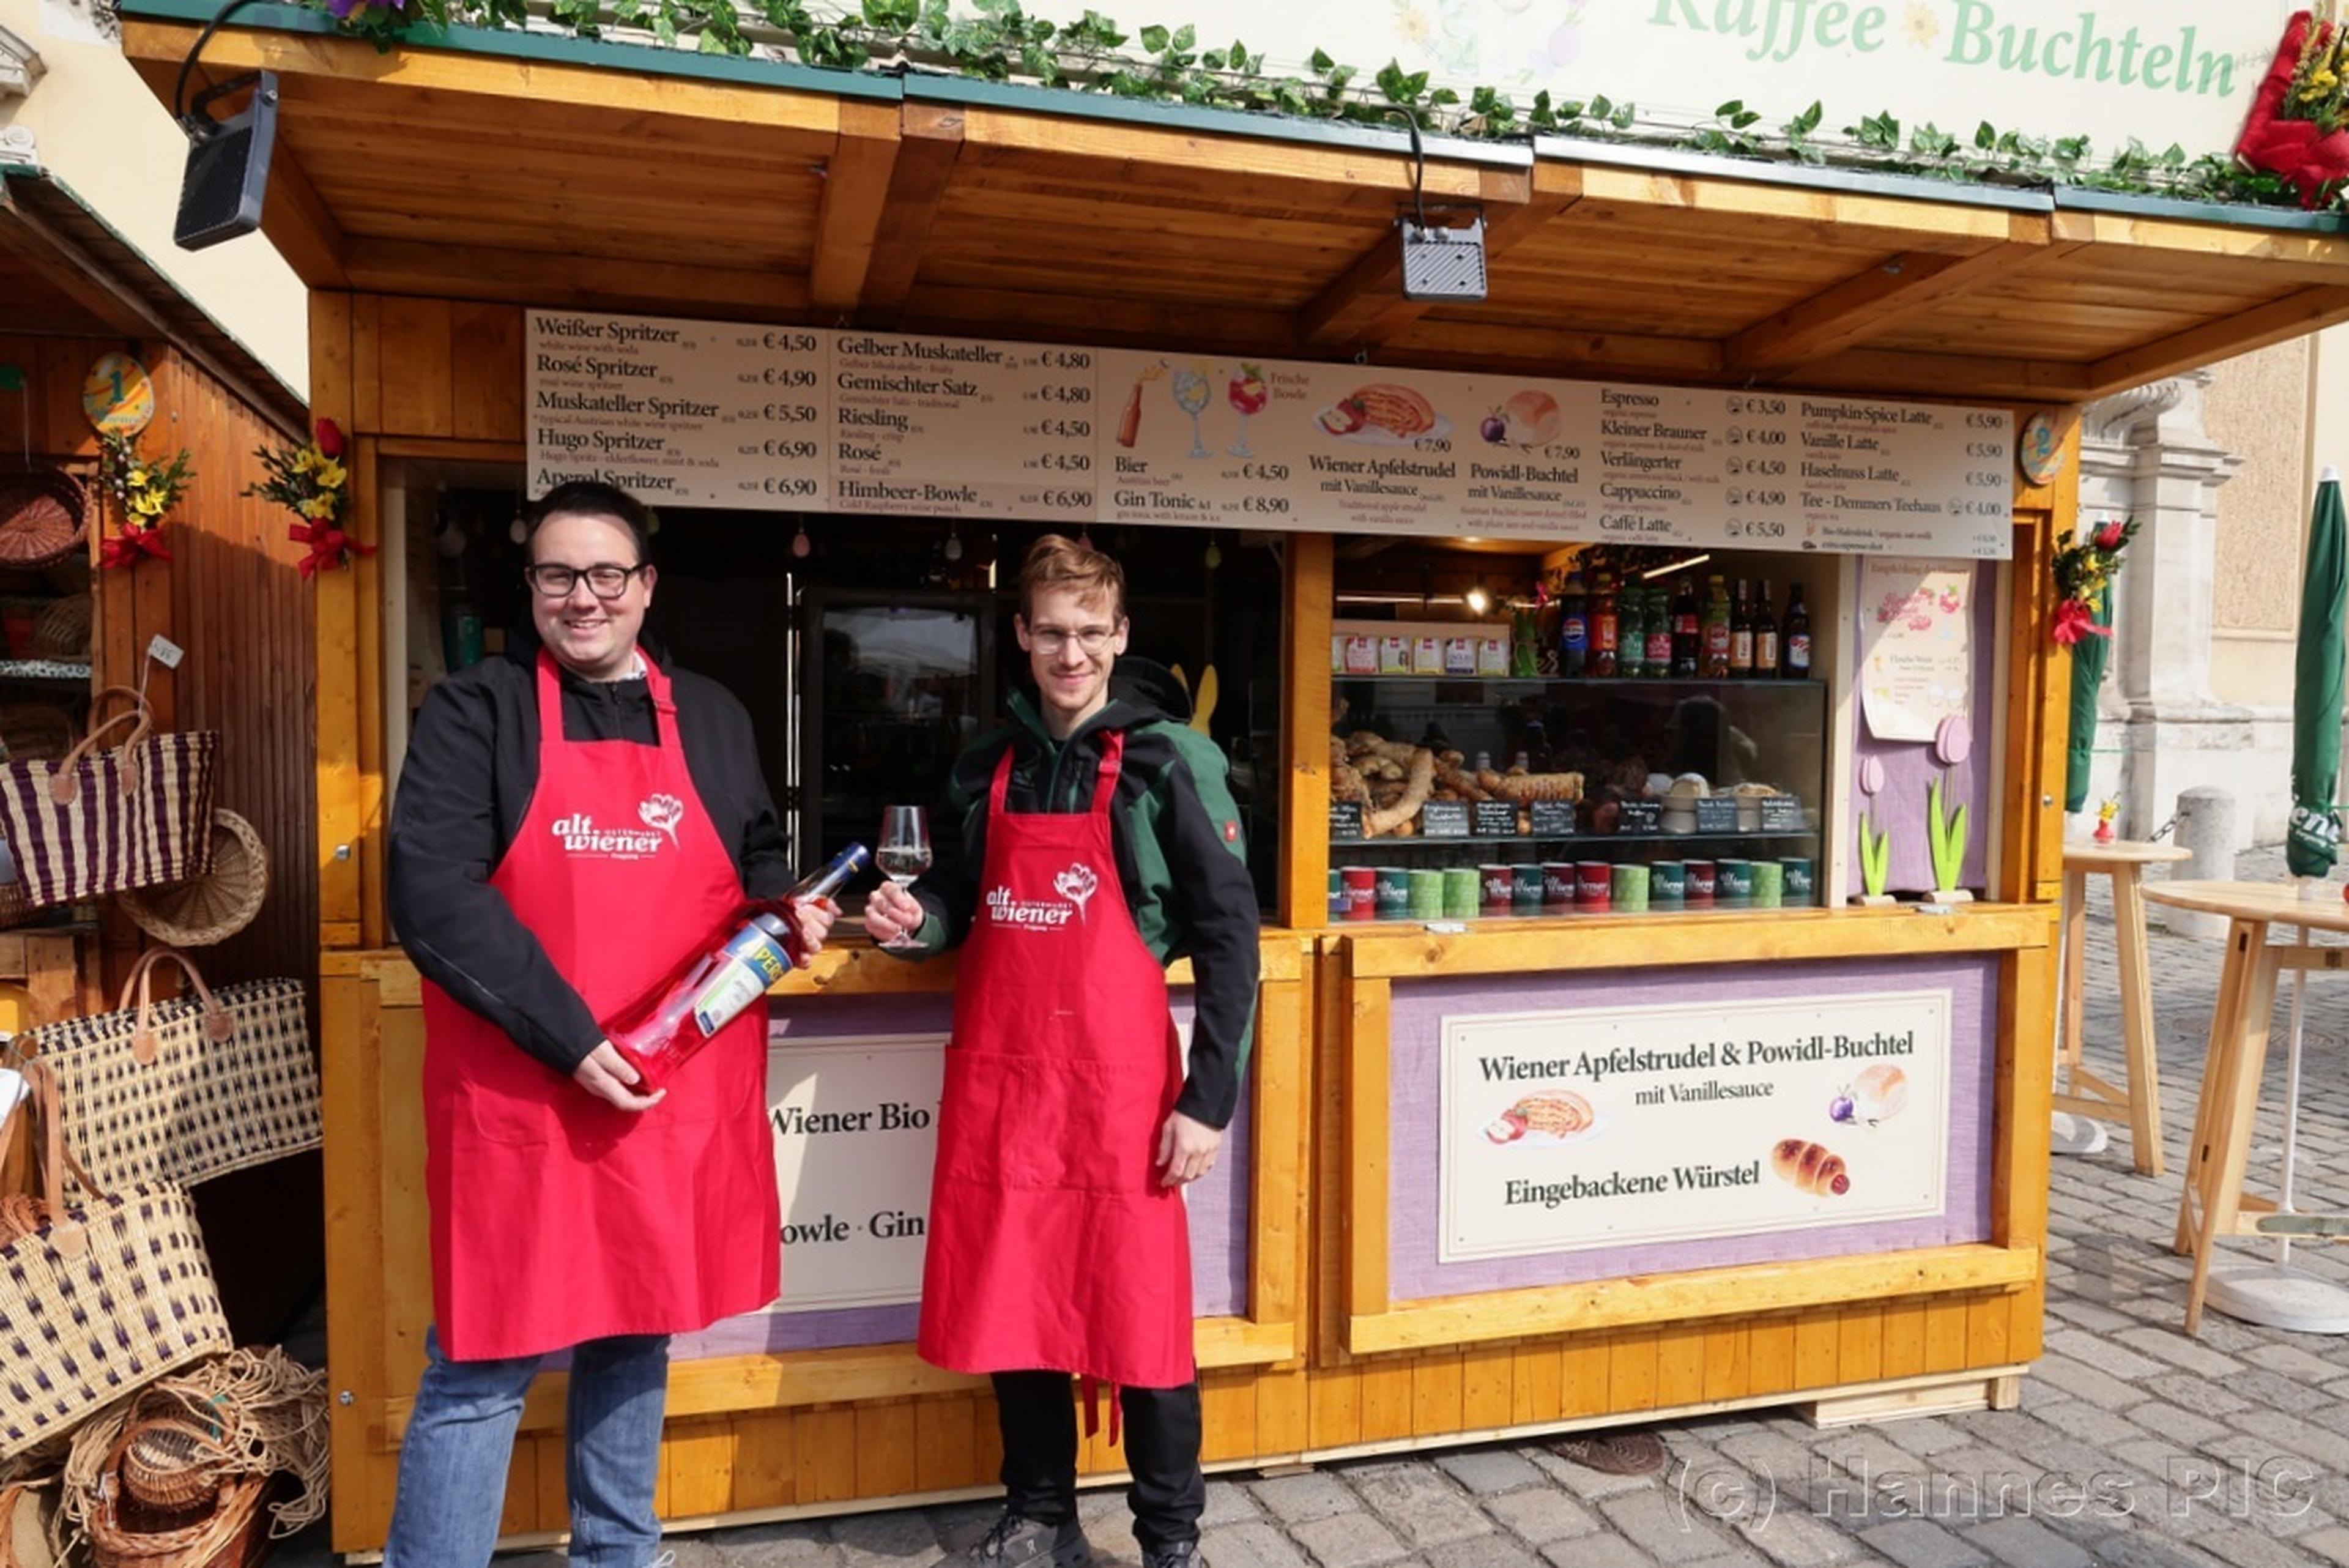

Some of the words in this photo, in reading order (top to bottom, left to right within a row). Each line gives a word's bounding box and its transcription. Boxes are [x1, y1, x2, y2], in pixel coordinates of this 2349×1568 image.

[1943, 0, 2235, 97] Buchteln
[536, 317, 604, 339] Weißer
[607, 323, 679, 346] Spritzer
[779, 334, 817, 352] 4,50
[837, 336, 898, 357] Gelber
[901, 343, 1003, 365] Muskateller
[1055, 352, 1090, 369] 4,80
[536, 355, 582, 373] Rosé
[585, 357, 658, 382] Spritzer
[779, 371, 816, 388] 4,90
[110, 371, 123, 404] 1
[837, 372, 940, 395] Gemischter
[943, 378, 978, 396] Satz
[1055, 387, 1091, 403] 4,80
[536, 392, 645, 414] Muskateller
[648, 398, 719, 422] Spritzer
[779, 406, 817, 423] 5,50
[1601, 388, 1659, 407] Espresso
[1758, 400, 1785, 414] 3,50
[838, 407, 908, 433] Riesling
[1055, 421, 1090, 437] 4,50
[1901, 409, 1932, 425] Latte
[1977, 415, 2002, 428] 5,90
[537, 429, 589, 452] Hugo
[592, 431, 665, 455] Spritzer
[779, 442, 817, 459] 6,90
[1601, 420, 1649, 437] Kleiner
[1653, 423, 1707, 439] Brauner
[1758, 431, 1785, 445] 4,00
[2037, 428, 2051, 455] 2
[838, 443, 881, 461] Rosé
[1055, 455, 1090, 470] 4,50
[1801, 433, 1844, 449] Vanille
[1847, 435, 1879, 450] Latte
[1977, 444, 2002, 458] 5,90
[1115, 456, 1148, 474] Bier
[1256, 464, 1289, 480] 4,50
[1309, 455, 1364, 474] Wiener
[1367, 458, 1455, 478] Apfelstrudel
[1600, 451, 1681, 471] Verlängerter
[1758, 461, 1785, 475] 4,50
[1800, 462, 1865, 479] Haselnuss
[1868, 466, 1899, 481] Latte
[1977, 474, 2002, 487] 5,90
[603, 471, 676, 491] Spritzer
[779, 480, 817, 498] 6,90
[838, 481, 977, 503] Himbeer-Bowle
[1056, 492, 1091, 508] 6,90
[1321, 480, 1341, 492] mit
[1345, 481, 1418, 496] Vanillesauce
[1469, 488, 1488, 498] mit
[1491, 488, 1562, 502] Vanillesauce
[1600, 483, 1681, 502] Cappuccino
[1758, 492, 1785, 506] 4,90
[1115, 490, 1145, 507] Gin
[1149, 491, 1195, 509] Tonic
[1256, 498, 1289, 514] 8,90
[1799, 492, 1822, 507] Tee
[1833, 495, 1891, 511] Demmers
[1895, 498, 1940, 513] Teehaus
[1977, 503, 2001, 516] 4,00
[1639, 517, 1671, 532] Latte
[1758, 522, 1784, 537] 5,50
[552, 814, 592, 835] alt
[564, 830, 662, 852] wiener
[986, 885, 1011, 905] alt
[992, 901, 1073, 924] wiener
[1480, 1056, 1570, 1082] Wiener
[1574, 1044, 1715, 1082] Apfelstrudel
[1722, 1042, 1742, 1064] &
[1748, 1031, 1913, 1064] Powidl-Buchtel
[1636, 1087, 1665, 1105] mit
[1669, 1080, 1774, 1102] Vanillesauce
[771, 1106, 873, 1134] Wiener
[879, 1102, 930, 1130] Bio
[1505, 1170, 1668, 1209] Eingebackene
[1673, 1161, 1760, 1191] Würstel
[781, 1214, 850, 1244] owle
[869, 1211, 925, 1239] Gin
